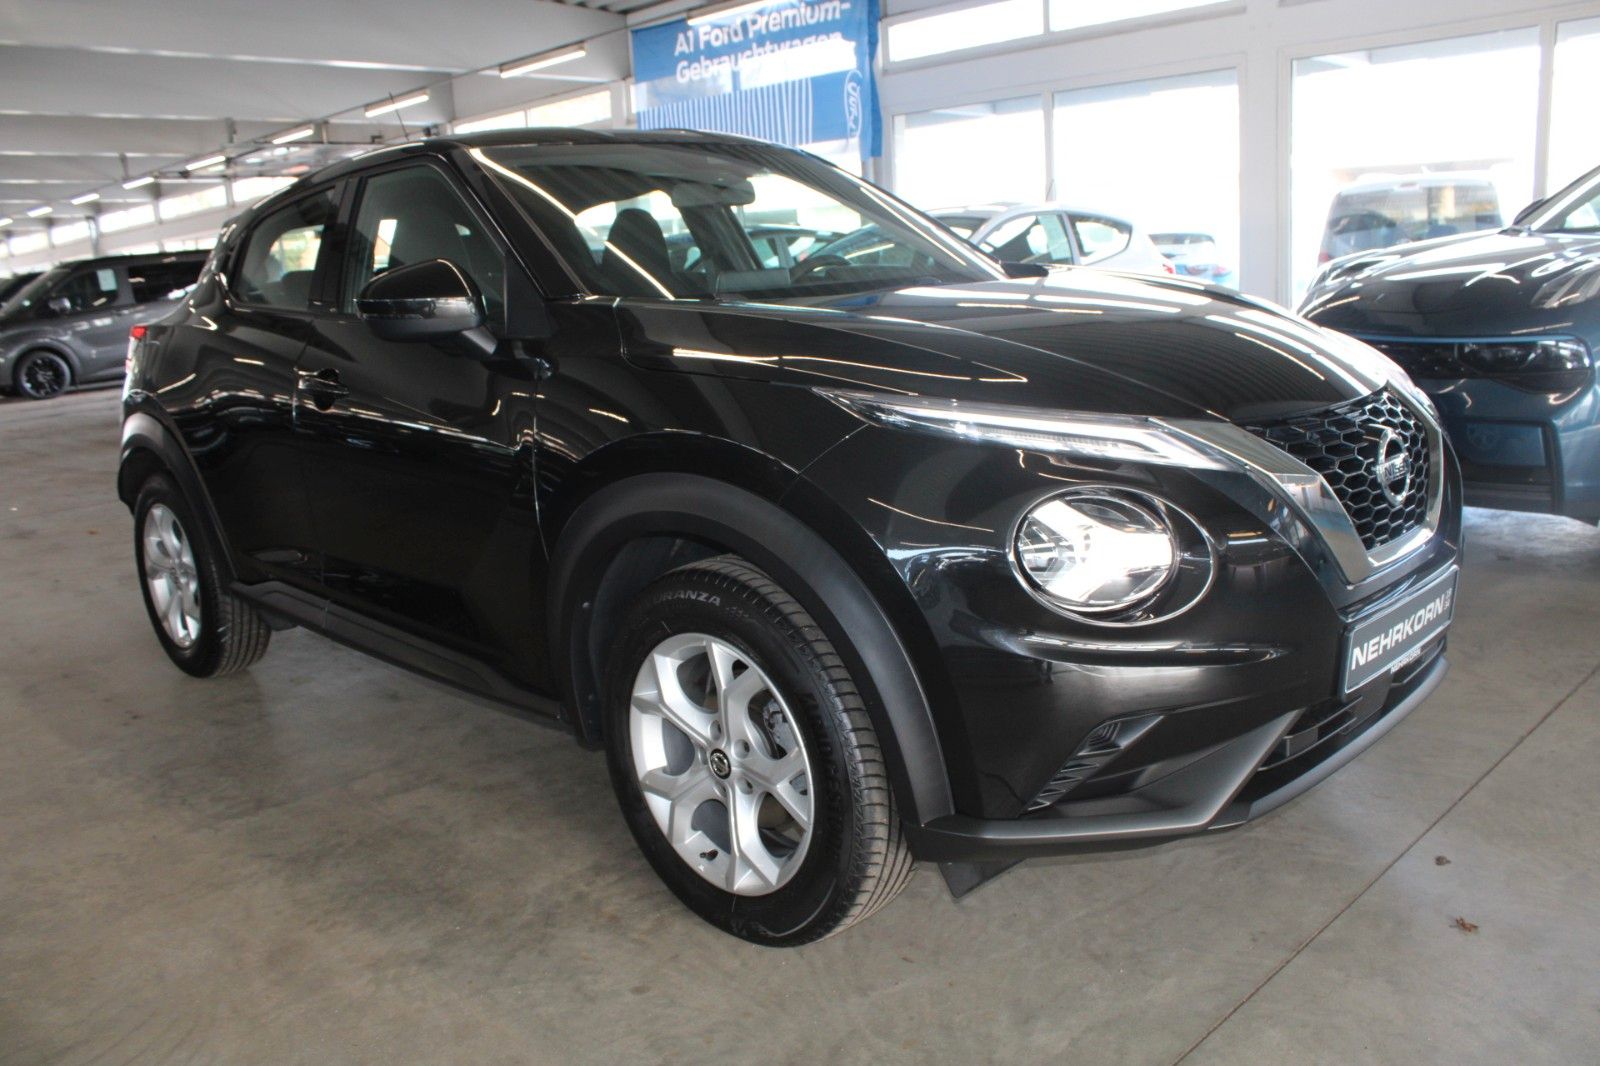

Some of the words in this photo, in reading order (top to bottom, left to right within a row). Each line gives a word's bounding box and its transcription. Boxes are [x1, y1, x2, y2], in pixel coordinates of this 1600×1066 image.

[699, 16, 744, 50] Ford
[749, 0, 851, 38] Premium-
[1350, 593, 1445, 670] NEHRKORN
